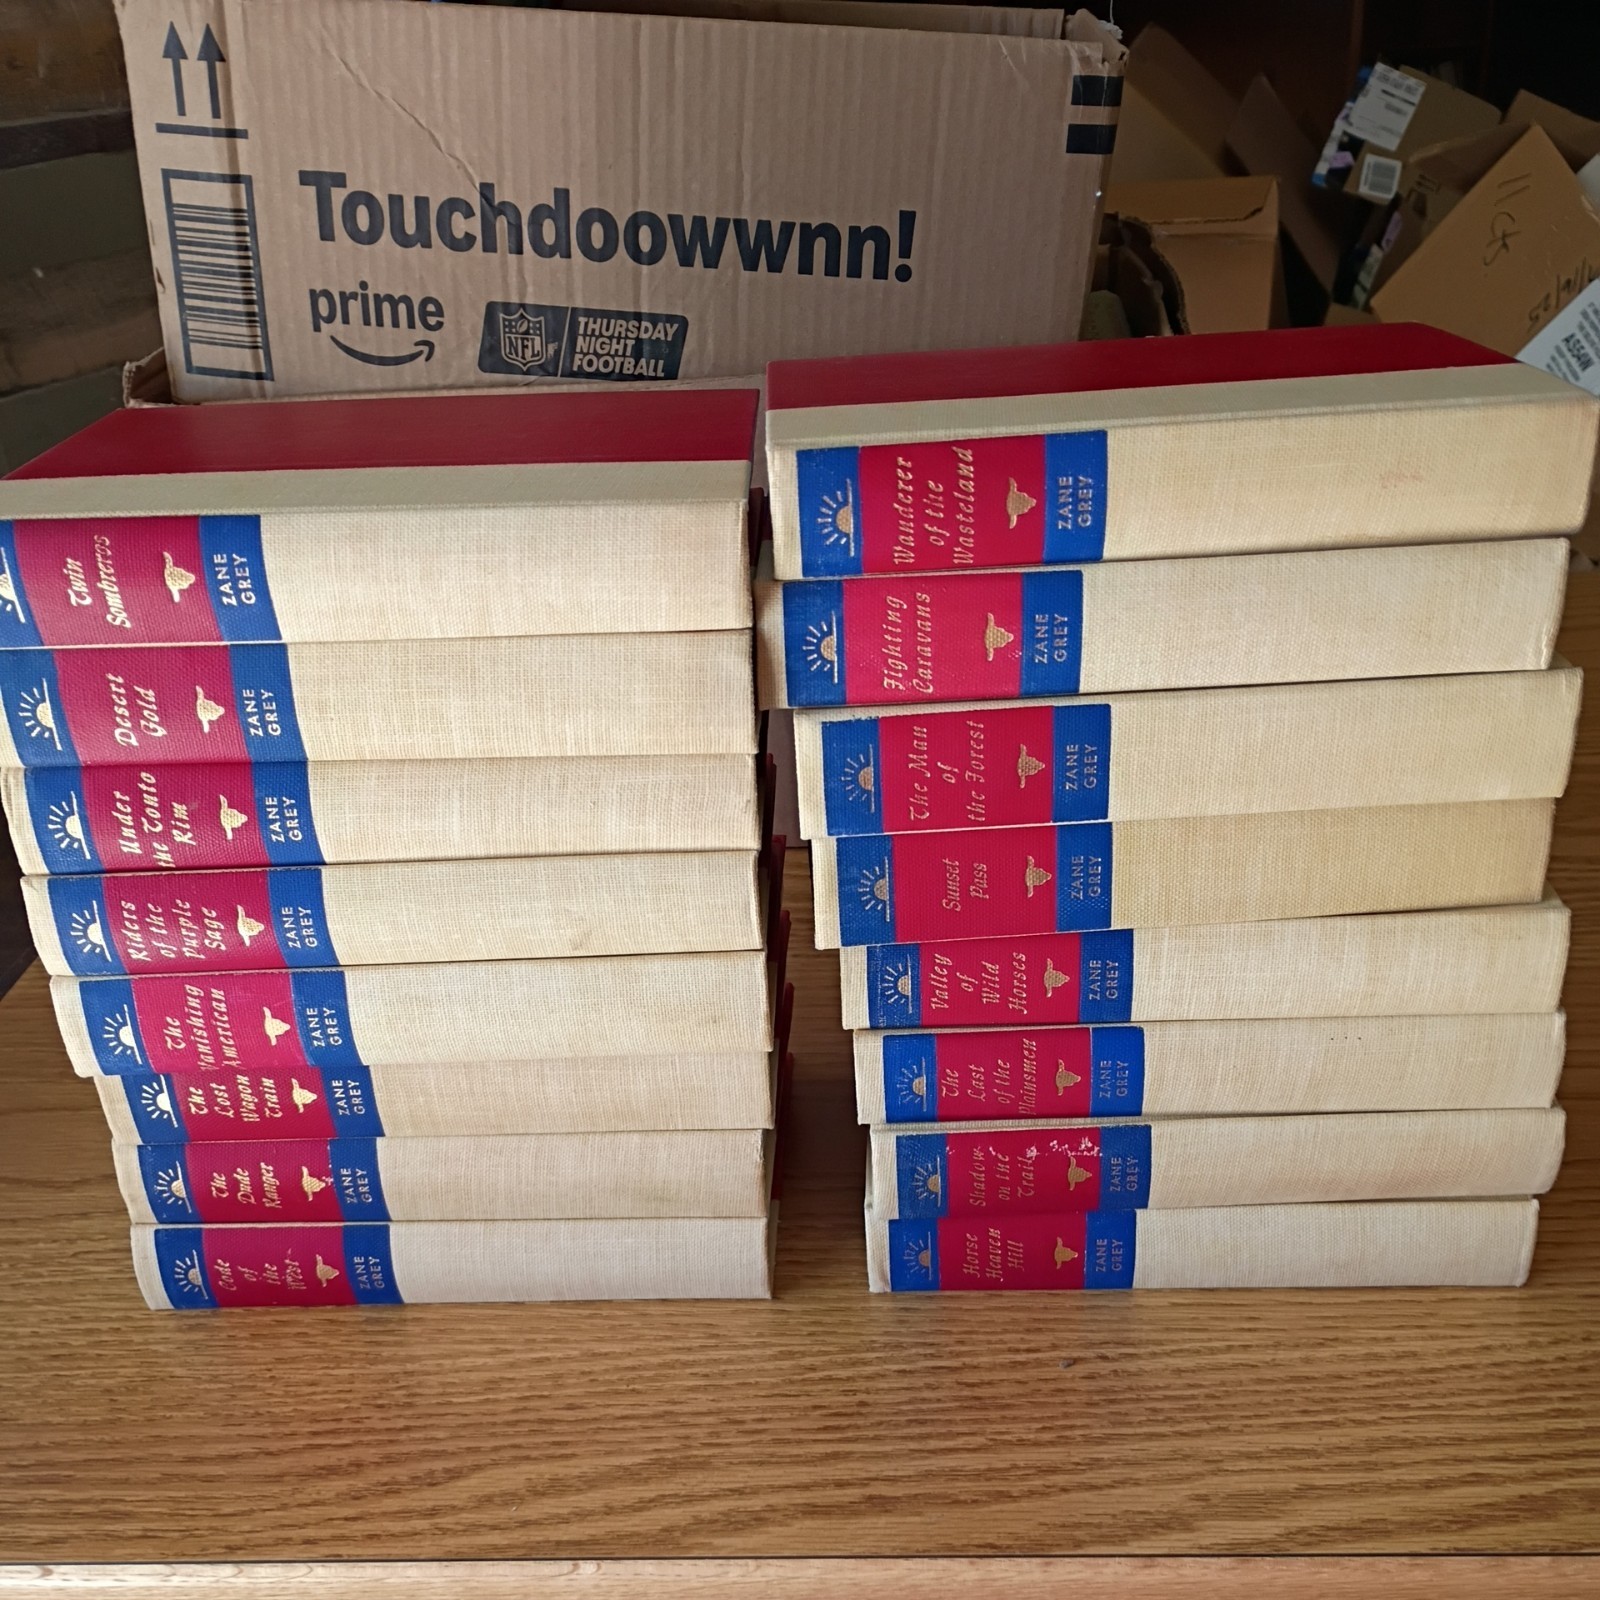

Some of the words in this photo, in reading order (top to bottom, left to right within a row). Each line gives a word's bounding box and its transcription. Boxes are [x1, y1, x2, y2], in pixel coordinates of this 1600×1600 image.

[299, 169, 917, 283] Touchdoowwnn!
[309, 281, 445, 333] prime
[505, 335, 542, 361] NFL
[575, 335, 636, 357] NIGHT
[577, 316, 679, 342] THURSDAY
[572, 354, 665, 377] FOOTBALL
[893, 456, 916, 566] Wanderer
[922, 480, 945, 520] the
[951, 446, 975, 565] Wasteland
[1057, 476, 1073, 530] ZANE
[1077, 476, 1094, 527] GREY
[923, 520, 950, 547] of
[63, 557, 92, 607] Twin
[94, 535, 131, 628] Sombreros
[214, 553, 237, 606] ZANE
[232, 554, 256, 604] GREY
[882, 595, 908, 691] Fighting
[912, 591, 934, 694] Caravans
[1034, 614, 1049, 664] ZANE
[1053, 613, 1070, 662] GREY
[106, 673, 139, 746] Desert
[134, 685, 166, 737] Gold
[243, 689, 263, 737] ZANE
[261, 689, 281, 735] GREY
[907, 725, 931, 777] Man
[964, 720, 985, 783] Forest
[1065, 744, 1080, 792] ZANE
[1083, 744, 1098, 789] GREY
[936, 762, 960, 785] of
[112, 791, 142, 854] Under
[138, 772, 163, 833] Tonto
[265, 797, 285, 843] ZANE
[282, 797, 303, 841] GREY
[909, 783, 931, 821] The
[967, 790, 987, 823] the
[172, 802, 196, 845] Rim
[154, 842, 175, 867] the
[941, 857, 962, 912] Sunset
[969, 862, 990, 900] Pass
[1070, 855, 1085, 900] ZANE
[1087, 855, 1103, 897] GREY
[121, 900, 151, 961] Riders
[146, 903, 167, 934] the
[202, 908, 226, 951] Sage
[281, 906, 301, 948] ZANE
[298, 907, 318, 948] GREY
[151, 933, 177, 958] of
[930, 953, 954, 1011] Valley
[955, 972, 977, 992] of
[980, 960, 1001, 1006] Wild
[1008, 951, 1028, 1015] Horses
[1088, 960, 1102, 1001] ZANE
[1105, 960, 1120, 999] GREY
[164, 1016, 186, 1051] The
[185, 985, 215, 1072] Vanishing
[210, 988, 240, 1070] American
[307, 1007, 326, 1047] ZANE
[323, 1007, 342, 1046] GREY
[941, 1068, 960, 1098] The
[967, 1064, 986, 1102] Last
[991, 1058, 1011, 1087] the
[1099, 1059, 1112, 1099] ZANE
[1116, 1060, 1129, 1097] GREY
[187, 1086, 208, 1115] The
[210, 1083, 235, 1119] Lost
[236, 1075, 260, 1122] Wagon
[260, 1077, 283, 1120] Train
[331, 1079, 350, 1115] ZANE
[348, 1080, 365, 1115] GREY
[992, 1089, 1016, 1105] of
[210, 1172, 229, 1199] The
[232, 1167, 256, 1204] Dude
[259, 1162, 282, 1209] Ranger
[338, 1168, 358, 1203] ZANE
[355, 1168, 373, 1203] GREY
[968, 1145, 987, 1208] Shadow
[997, 1186, 1011, 1202] on
[1109, 1156, 1122, 1193] ZANE
[1126, 1156, 1139, 1191] GREY
[214, 1258, 237, 1291] Code
[237, 1266, 258, 1282] of
[262, 1263, 282, 1285] the
[354, 1255, 371, 1290] ZANE
[368, 1256, 385, 1289] GREY
[962, 1232, 981, 1279] Horse
[985, 1227, 1003, 1281] Heaven
[1008, 1240, 1025, 1273] Hill
[1096, 1238, 1109, 1273] ZANE
[1111, 1238, 1124, 1271] GREY
